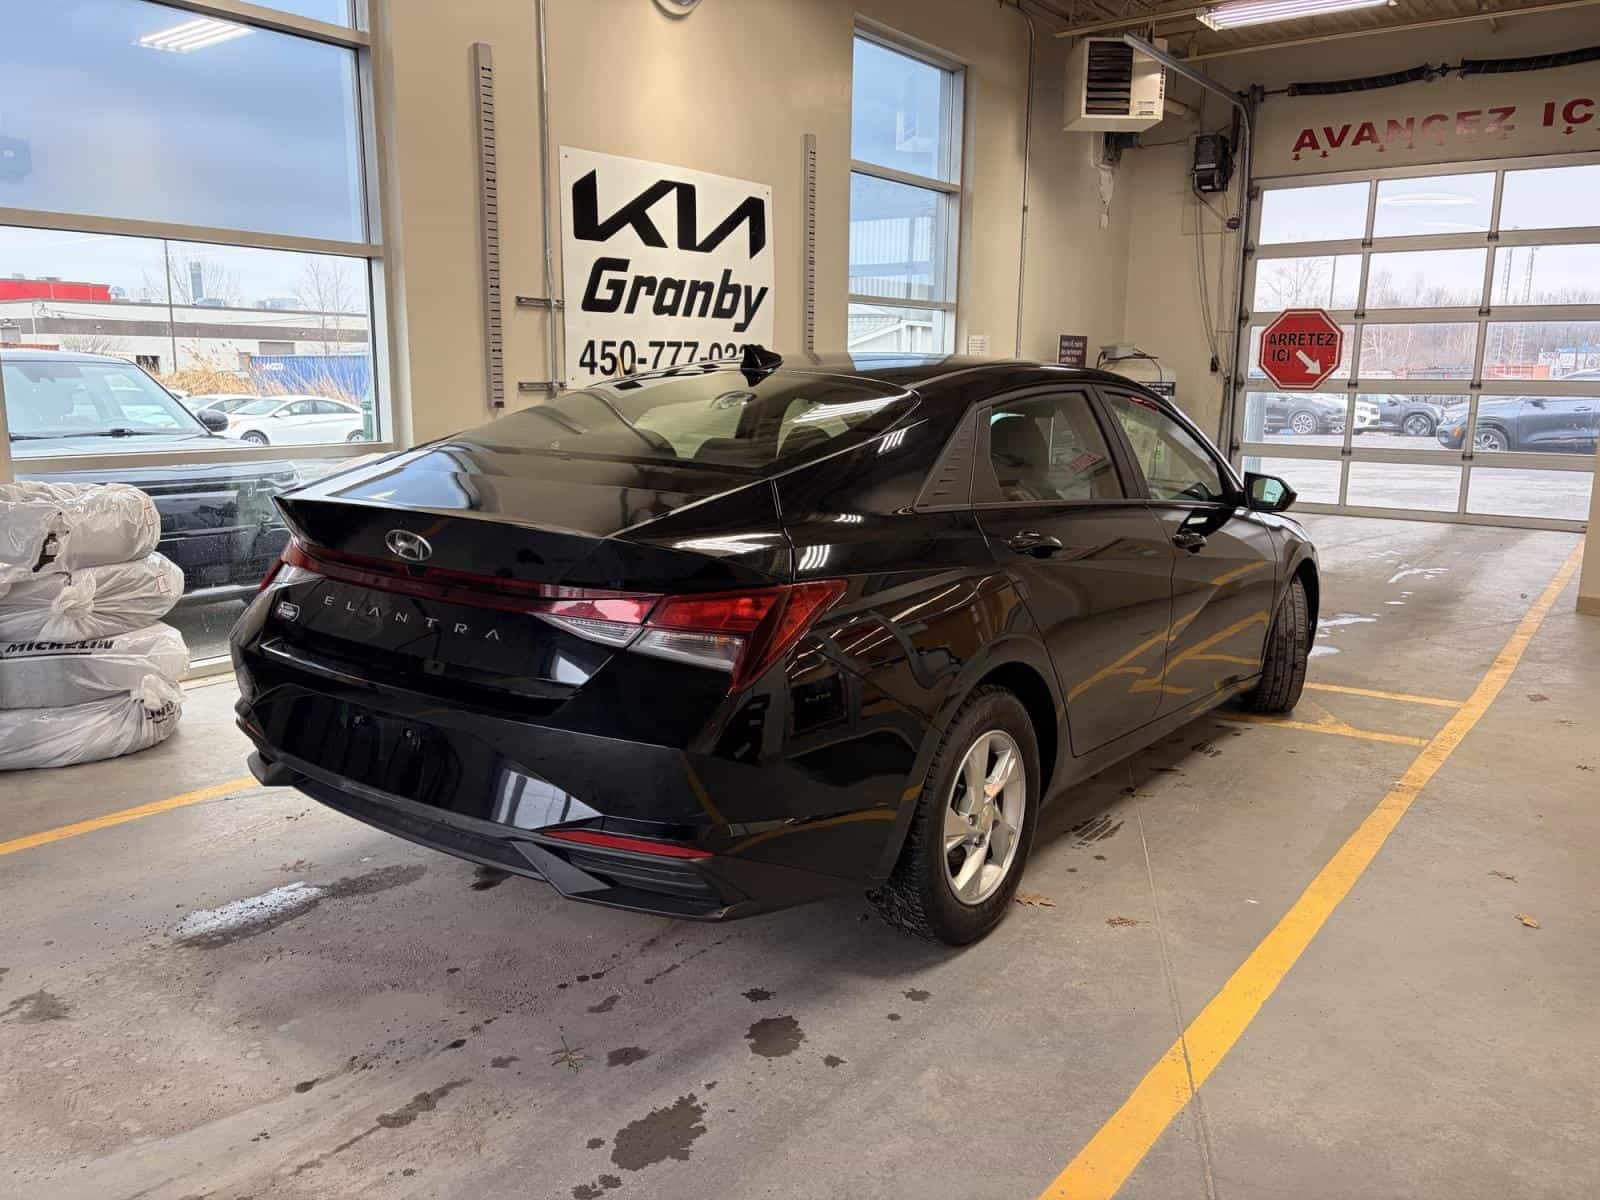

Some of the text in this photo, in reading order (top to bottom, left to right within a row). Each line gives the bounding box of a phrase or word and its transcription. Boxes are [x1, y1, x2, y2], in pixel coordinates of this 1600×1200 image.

[1292, 98, 1595, 153] AVANCEZ IC
[572, 168, 766, 260] KIA
[581, 256, 769, 332] Granby
[1271, 349, 1290, 361] ICI
[323, 595, 501, 641] ELANTRA
